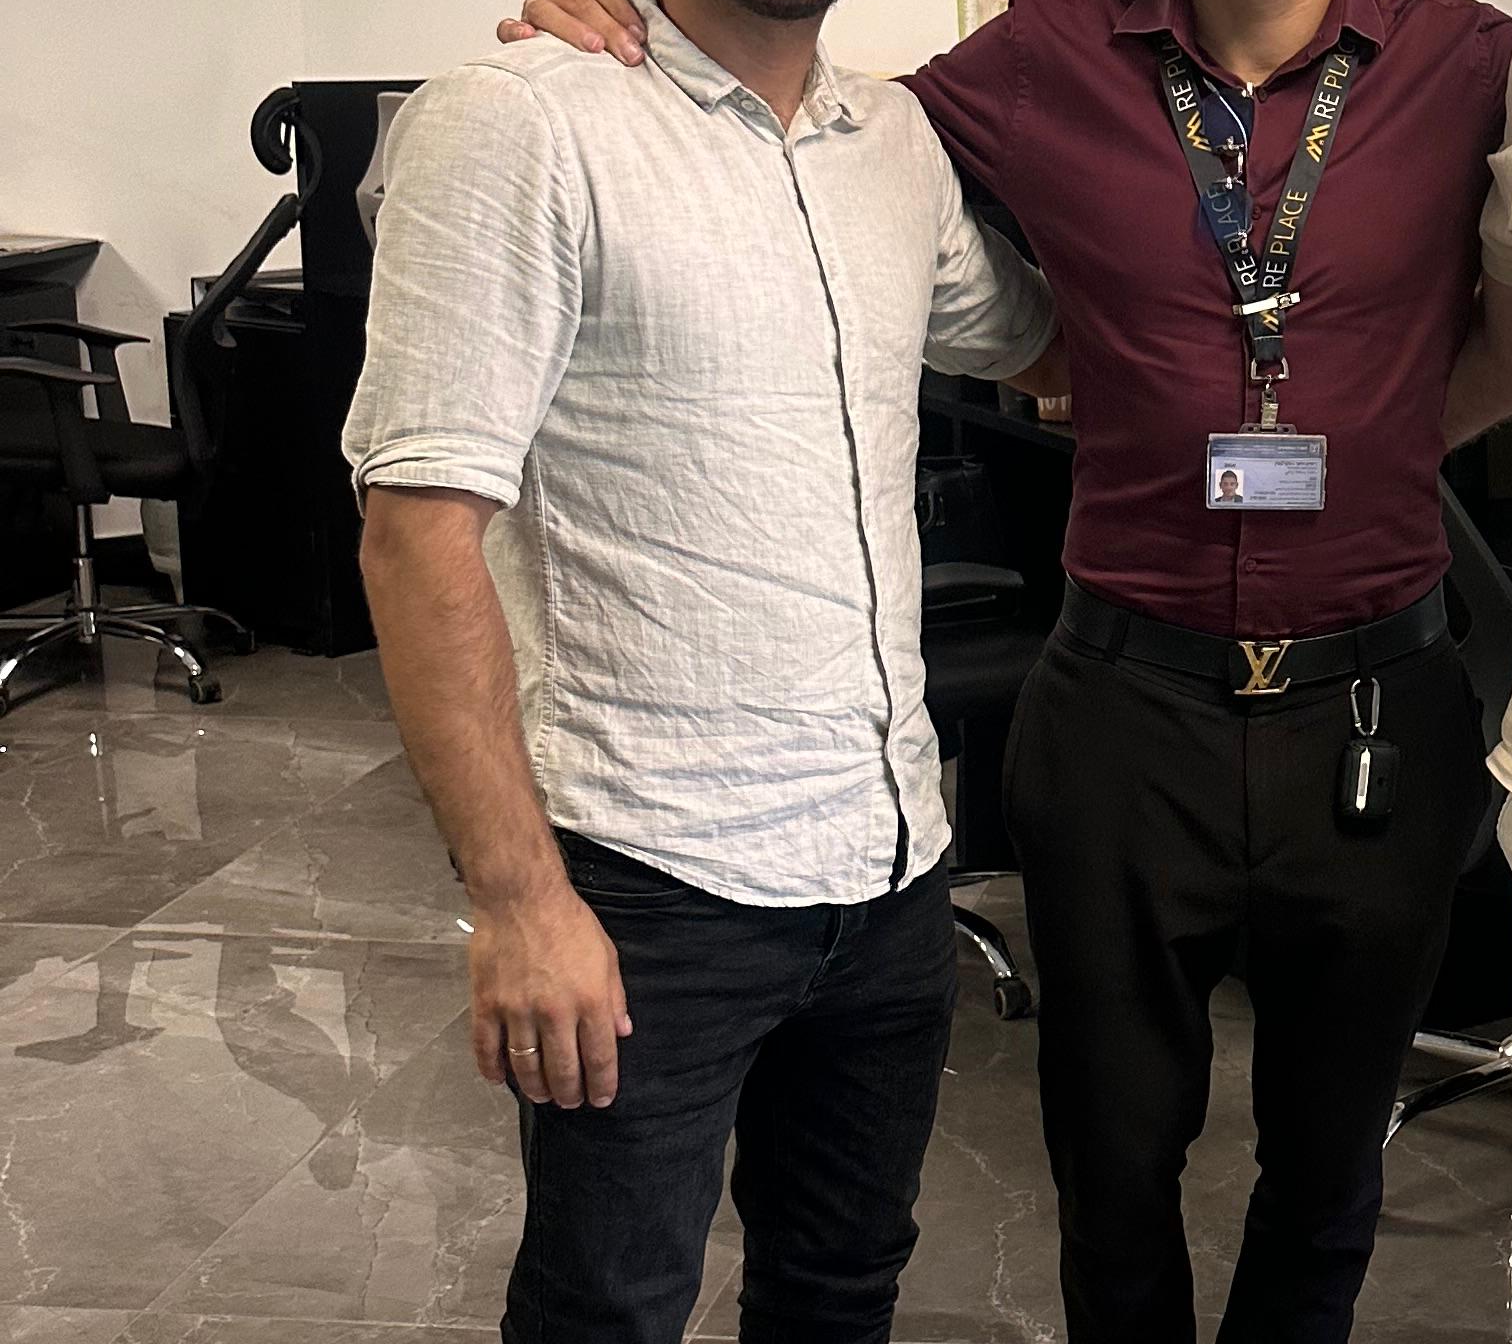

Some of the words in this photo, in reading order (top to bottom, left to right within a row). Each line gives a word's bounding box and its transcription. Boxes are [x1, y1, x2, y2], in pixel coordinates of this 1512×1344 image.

[1171, 79, 1197, 112] RE
[1313, 91, 1340, 120] RE
[1270, 188, 1308, 256] PLACE
[1234, 255, 1258, 286] RE
[1262, 260, 1288, 288] RE
